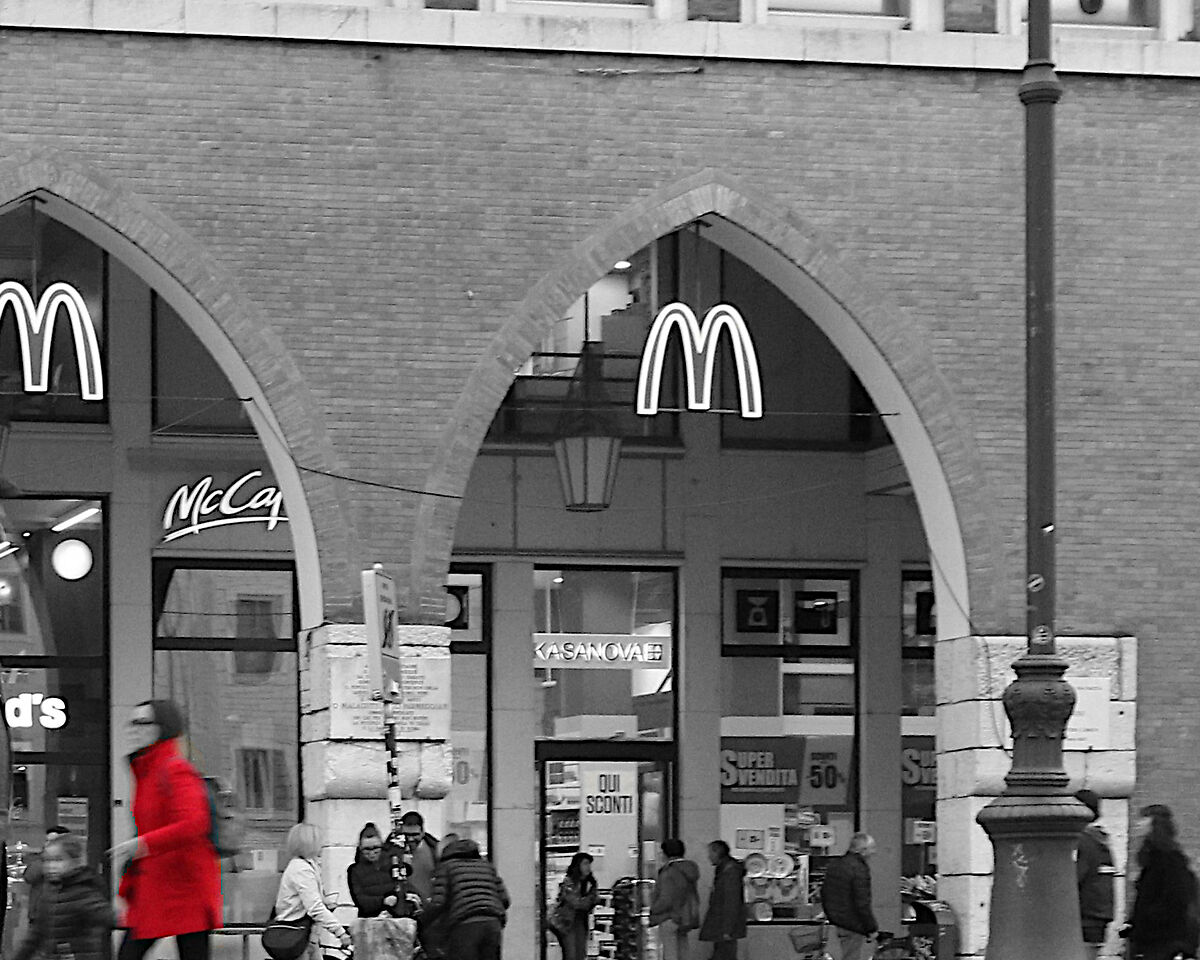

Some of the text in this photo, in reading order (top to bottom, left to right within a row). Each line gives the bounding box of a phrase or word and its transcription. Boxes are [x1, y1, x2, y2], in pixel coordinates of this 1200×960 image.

[535, 641, 644, 661] KASANOVA
[600, 774, 620, 793] QUI
[586, 795, 632, 814] SCONTI
